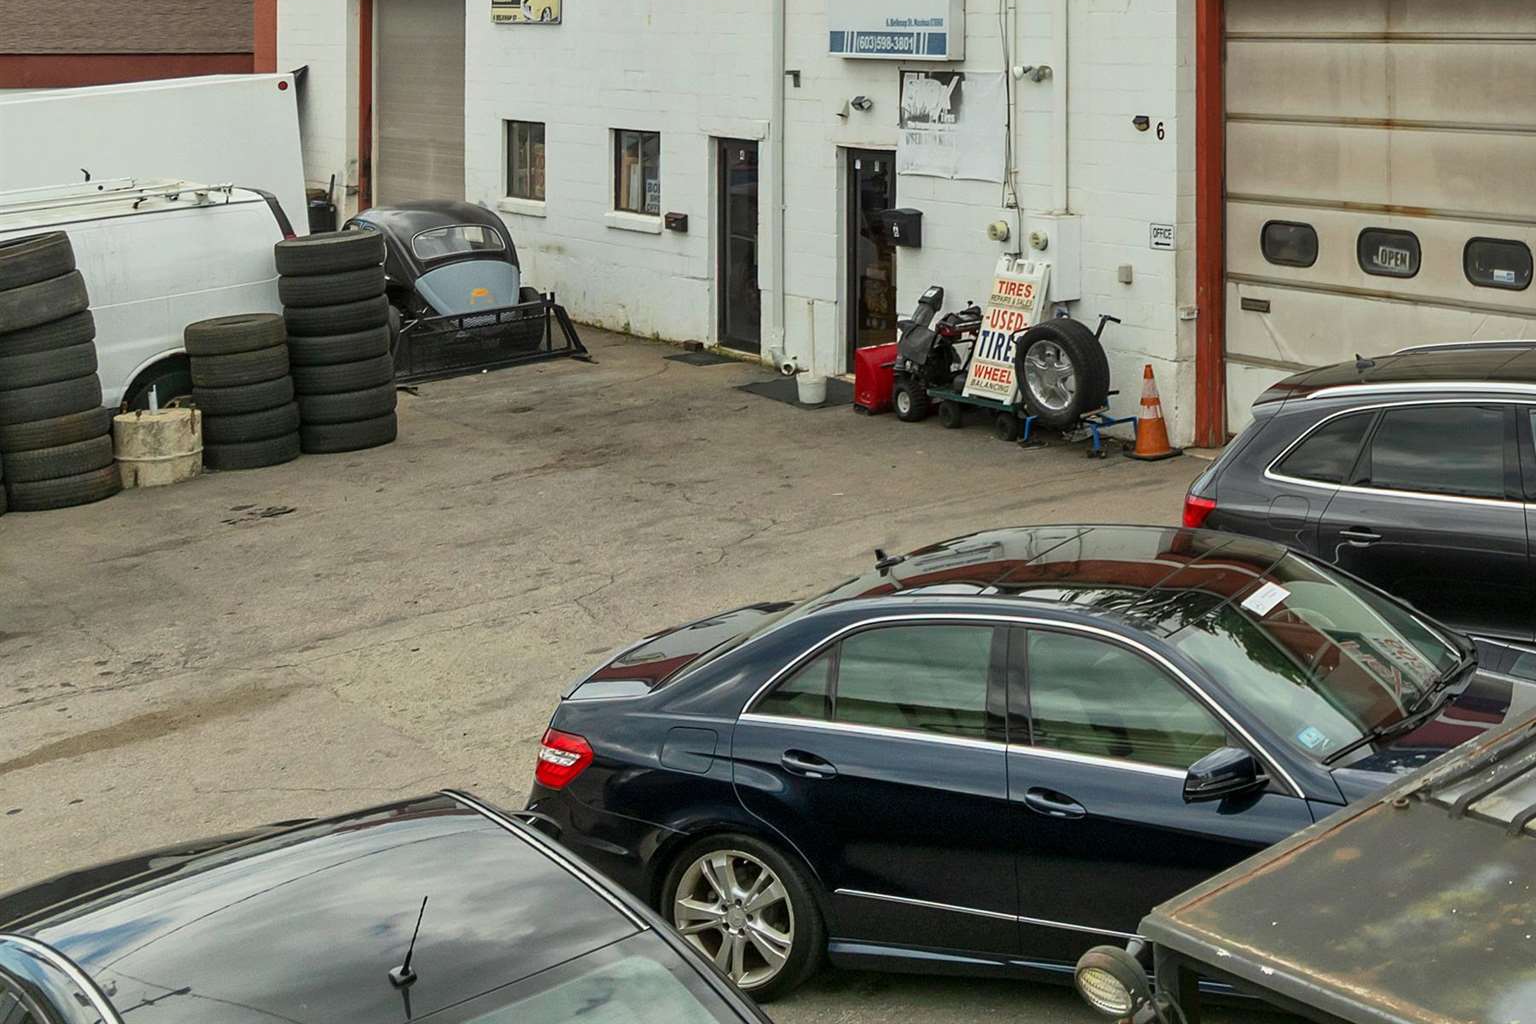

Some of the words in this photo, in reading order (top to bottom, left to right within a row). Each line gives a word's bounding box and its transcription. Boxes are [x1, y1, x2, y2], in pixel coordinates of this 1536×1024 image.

[1156, 121, 1165, 140] 6
[1152, 227, 1172, 239] OFFICE
[1380, 247, 1408, 266] OPEN
[998, 280, 1033, 299] TIRES
[978, 330, 1018, 363] TIRE
[974, 364, 1012, 384] WHEEL
[970, 379, 1010, 394] BALANCING
